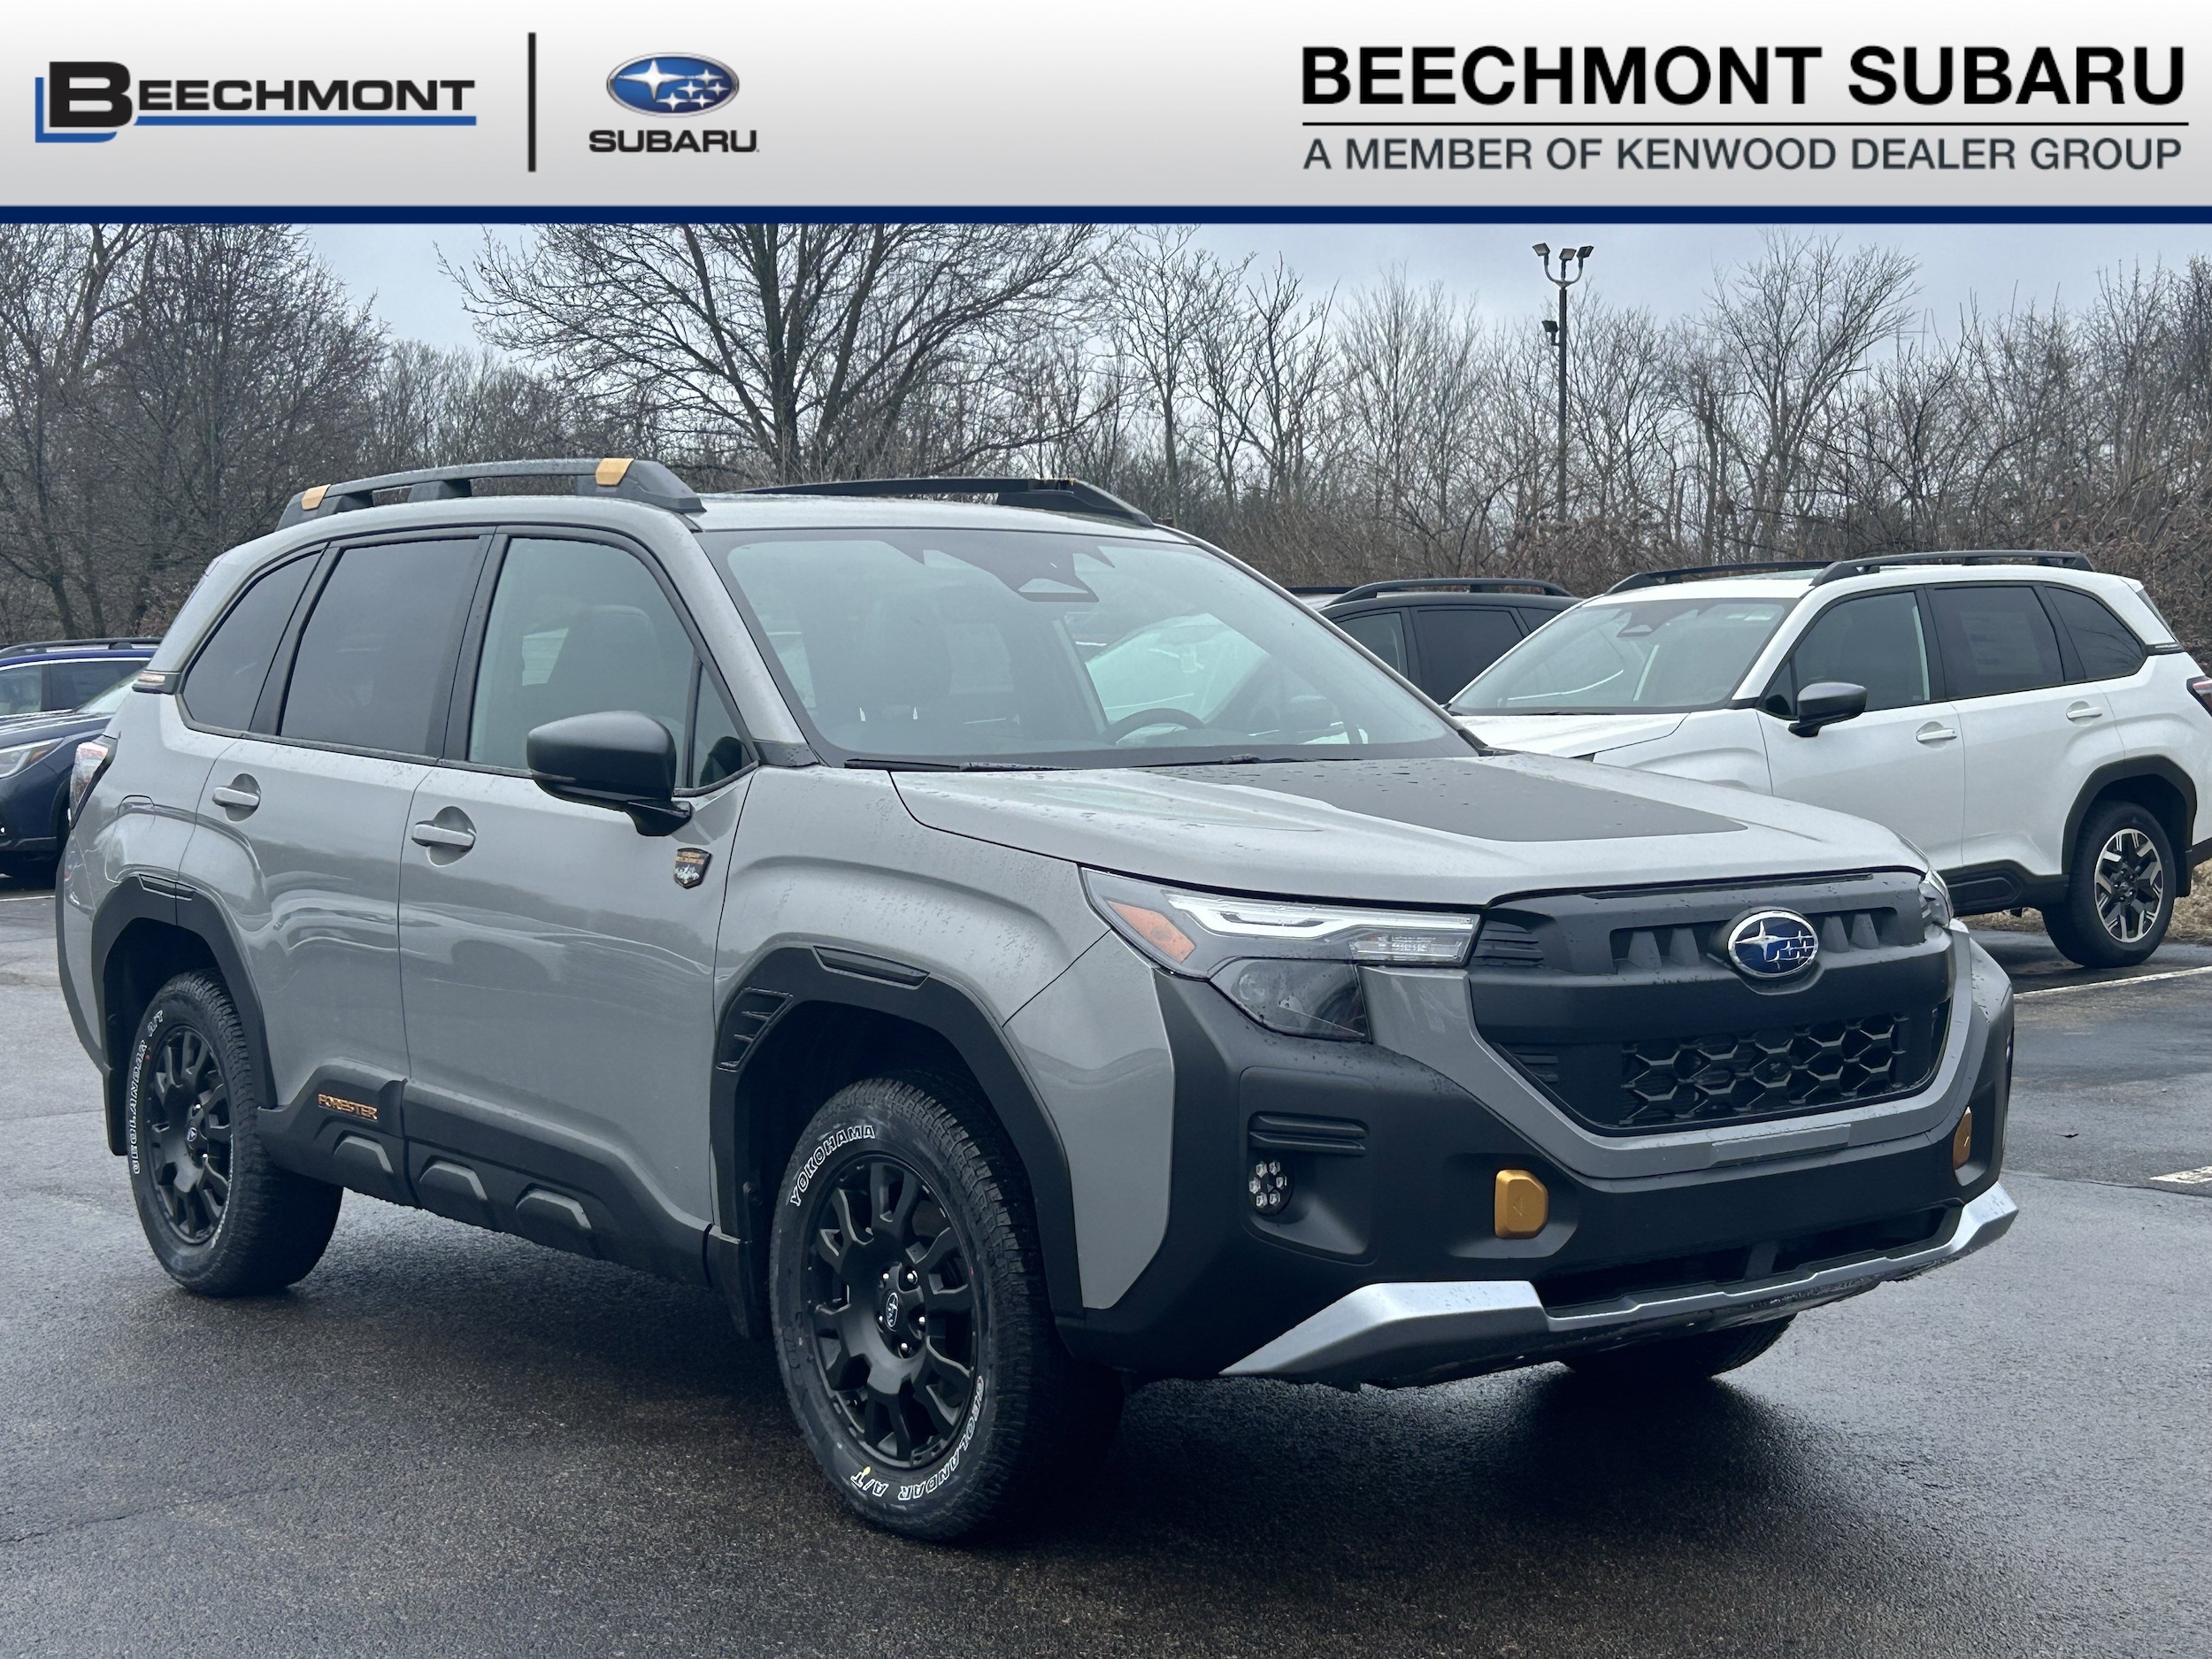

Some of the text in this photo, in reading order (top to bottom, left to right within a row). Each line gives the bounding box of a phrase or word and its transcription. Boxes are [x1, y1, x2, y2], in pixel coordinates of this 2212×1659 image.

[318, 1094, 378, 1119] FORESTER
[790, 1125, 876, 1207] YOKOHAMA
[849, 1375, 985, 1502] GEOLANDAR A/T
